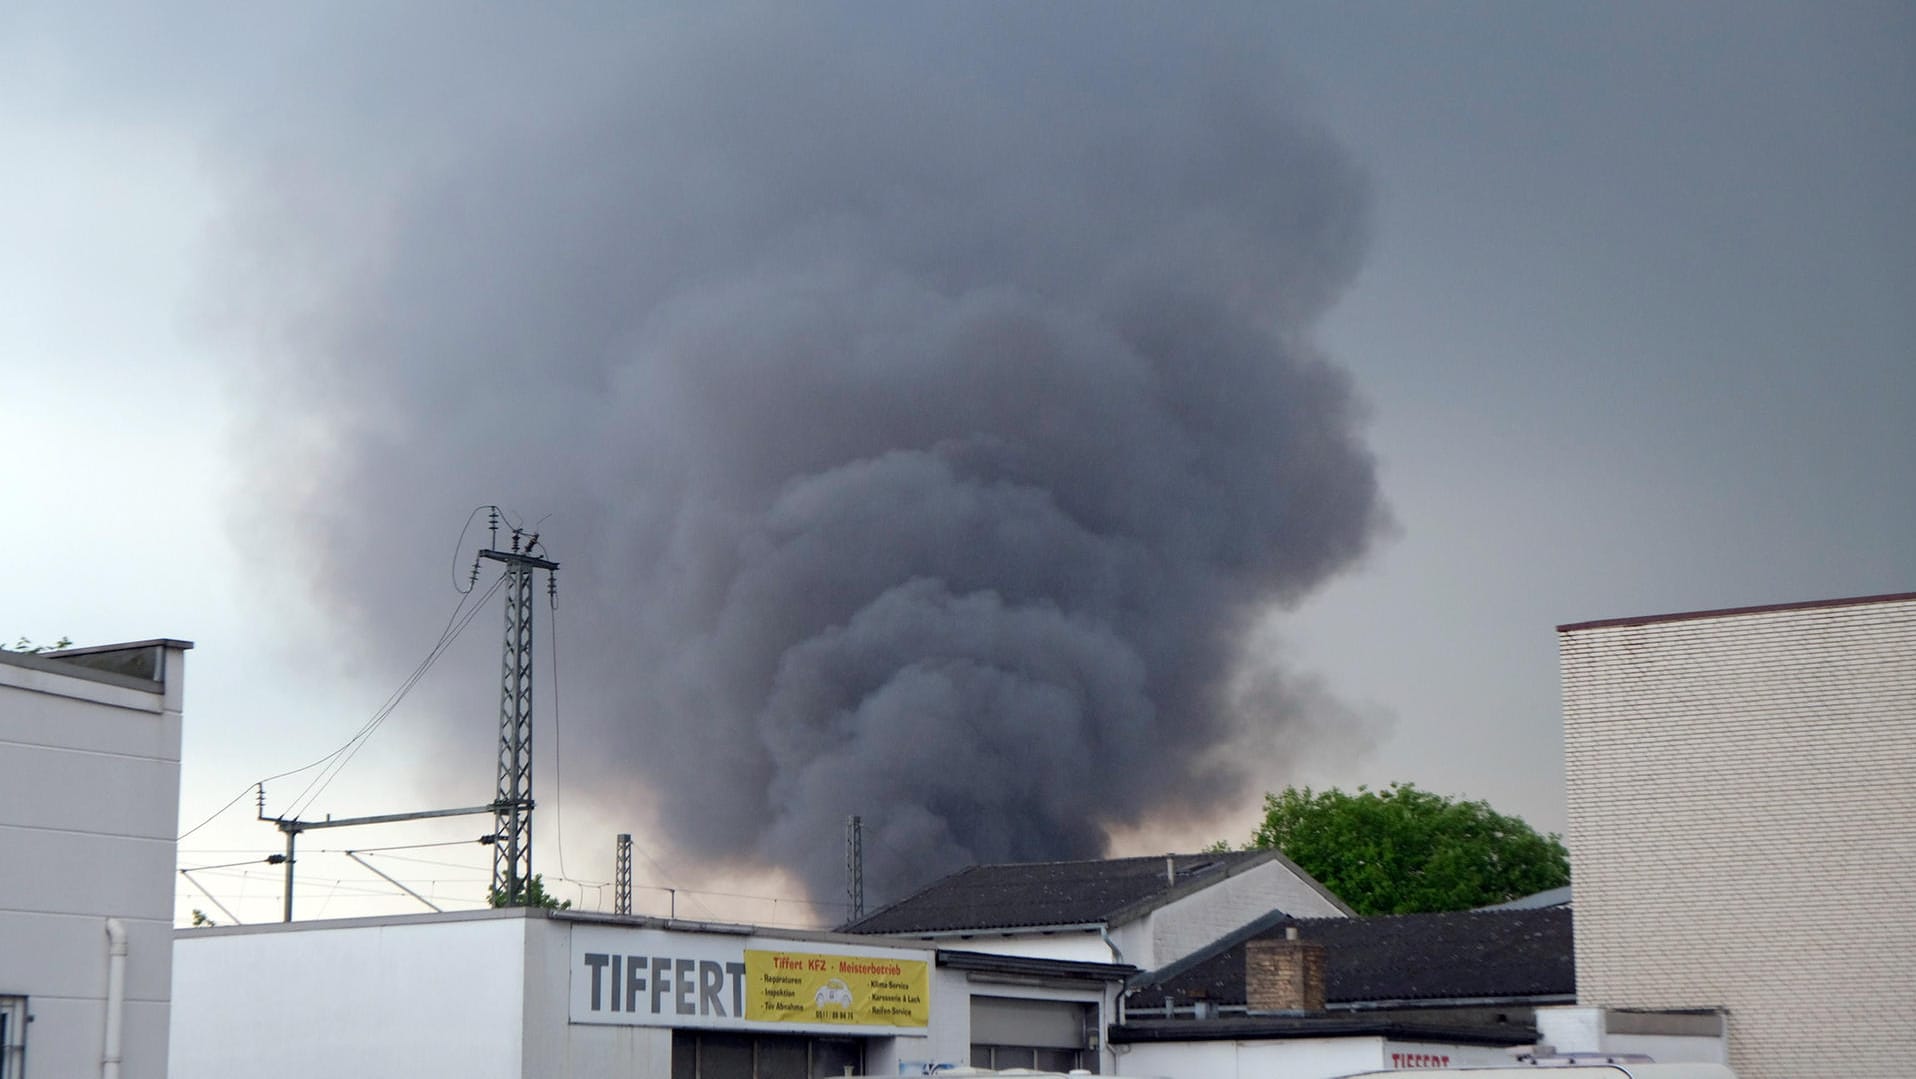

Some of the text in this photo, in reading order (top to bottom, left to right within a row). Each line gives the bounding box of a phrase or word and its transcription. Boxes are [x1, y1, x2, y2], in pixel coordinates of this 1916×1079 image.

[584, 953, 746, 1018] TIFFERT
[773, 957, 901, 976] Tiffert KFZ Meisterbetrieb
